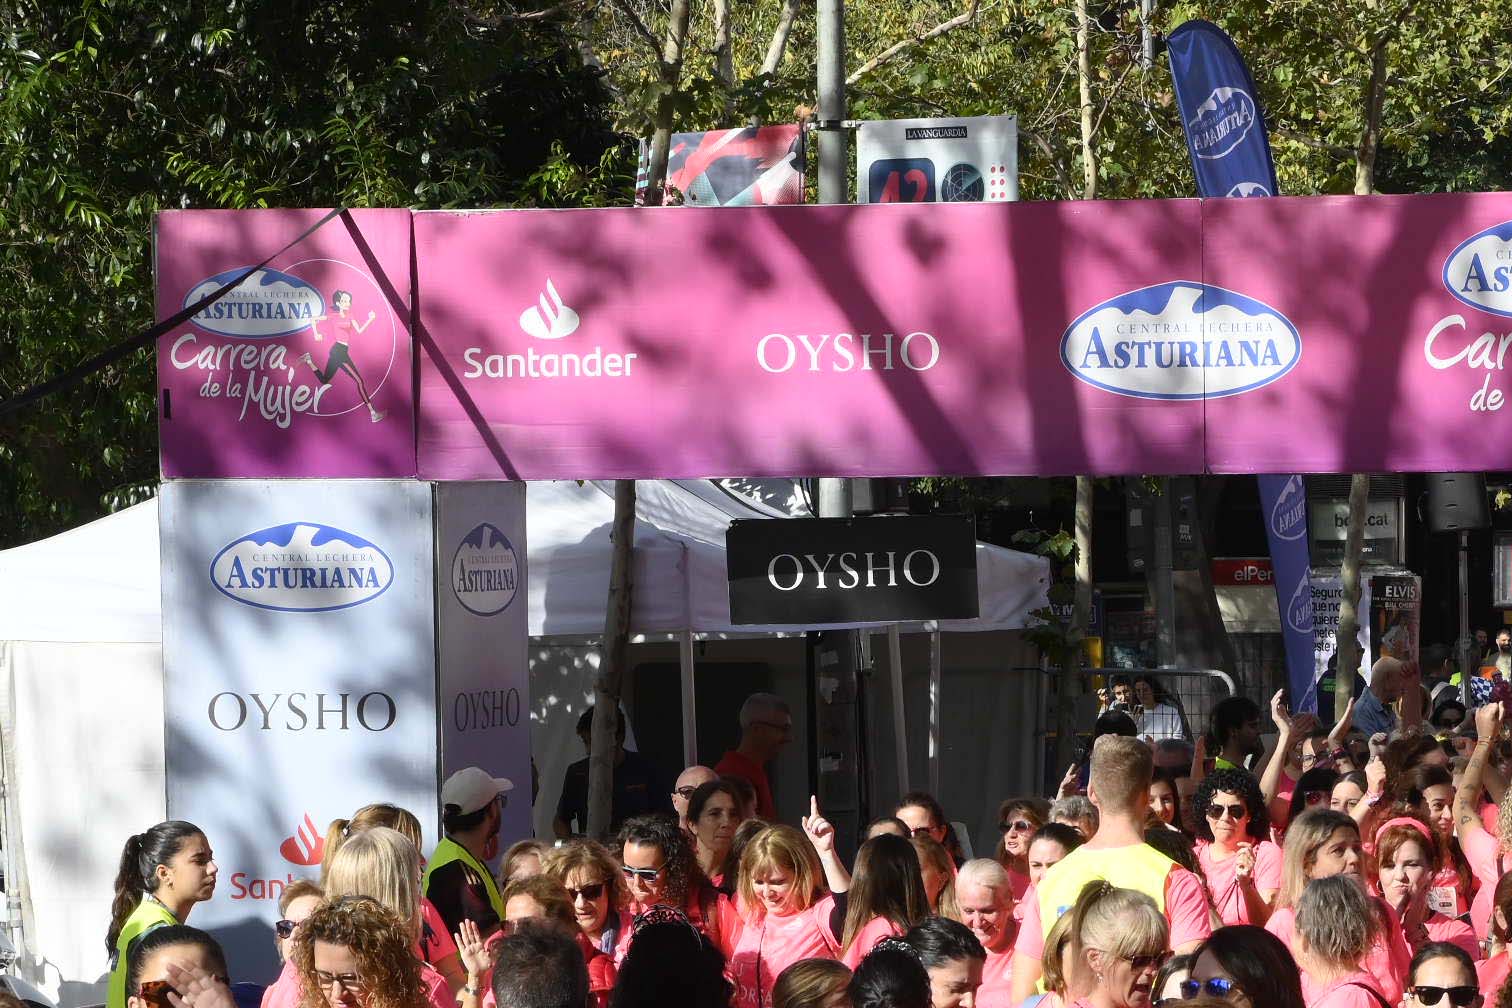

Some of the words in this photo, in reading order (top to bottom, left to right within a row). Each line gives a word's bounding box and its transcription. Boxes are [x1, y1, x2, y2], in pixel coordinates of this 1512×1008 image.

[1115, 323, 1192, 335] CENTRAL
[170, 333, 288, 370] Carrera
[463, 346, 638, 379] Santander
[756, 332, 940, 373] OYSHO
[1079, 326, 1282, 369] ASTURIANA
[200, 373, 221, 398] de
[226, 373, 241, 398] la
[238, 367, 333, 429] Mujer
[1470, 373, 1505, 411] de
[225, 555, 381, 590] ASTURIANA
[252, 552, 311, 563] CENTRAL
[316, 552, 375, 563] LECHERA
[457, 558, 515, 593] ASTURIANA
[767, 549, 940, 592] OYSHO
[1234, 565, 1273, 581] elPer
[1385, 585, 1416, 599] ELVIS
[1312, 613, 1340, 627] quiere
[207, 691, 397, 733] OYSHO
[454, 688, 520, 733] OYSHO
